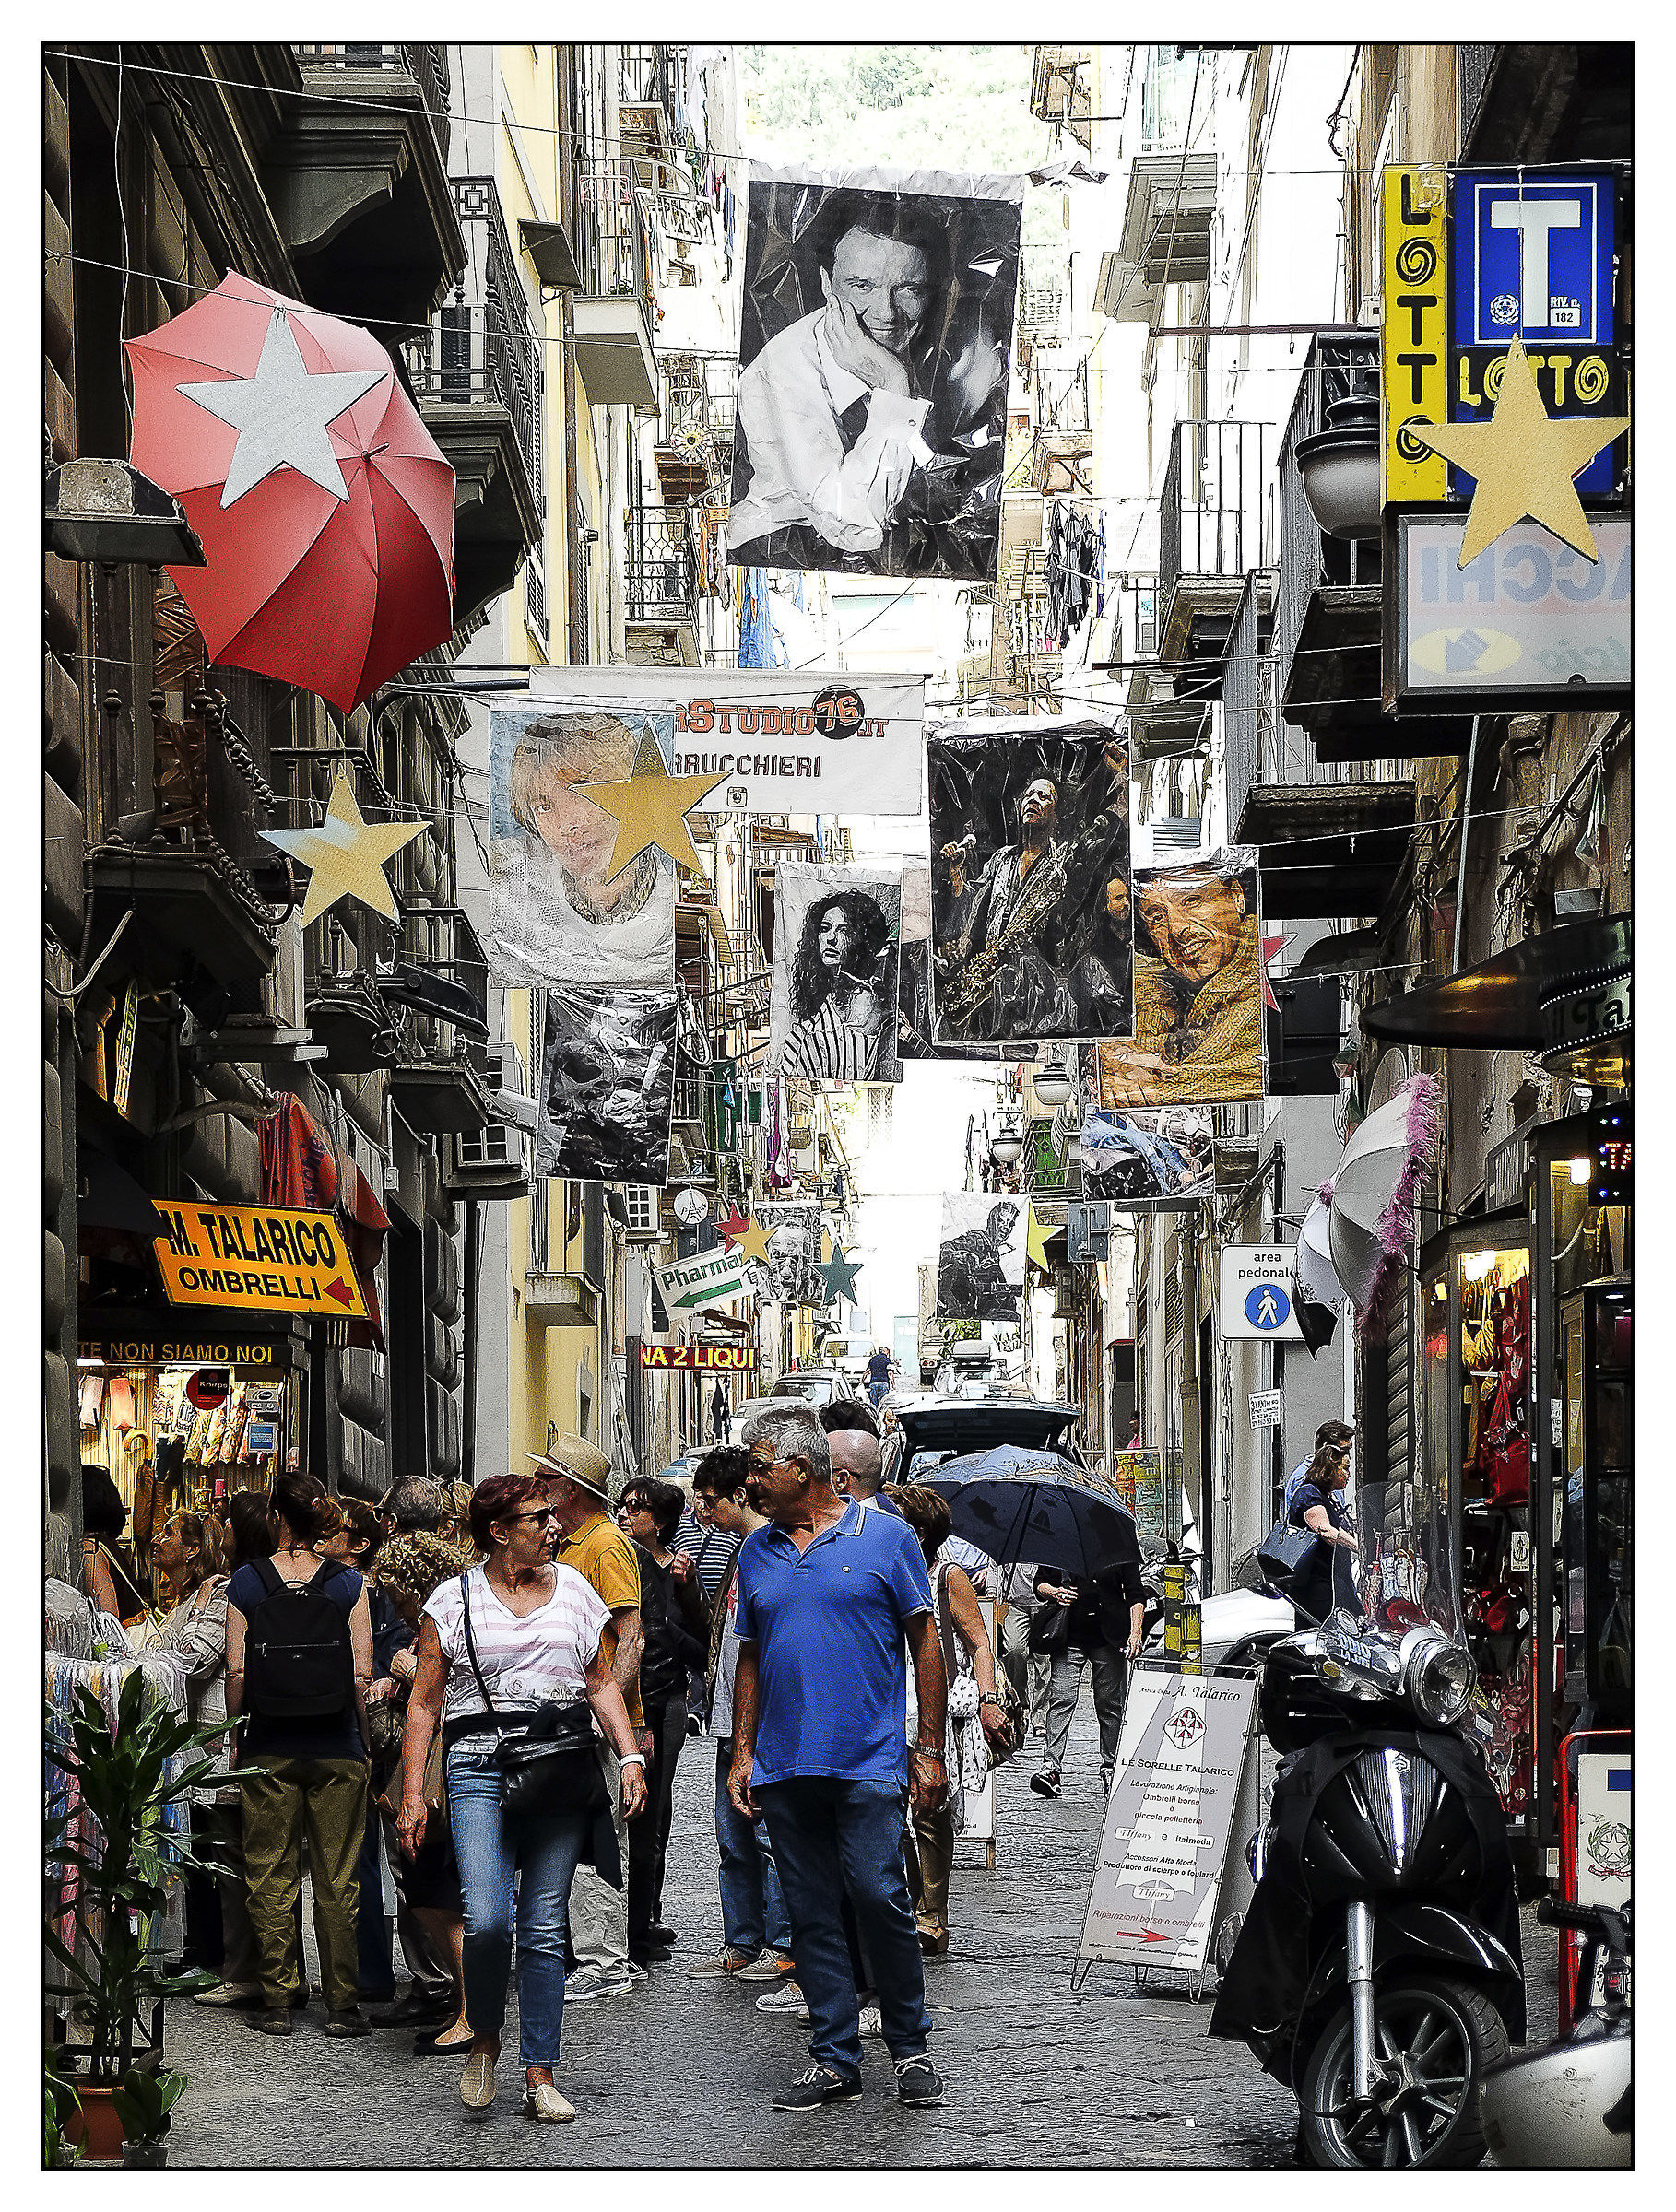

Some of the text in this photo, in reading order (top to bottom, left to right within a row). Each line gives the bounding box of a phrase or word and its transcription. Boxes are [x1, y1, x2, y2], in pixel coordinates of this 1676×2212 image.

[1490, 200, 1582, 327] T
[1395, 173, 1438, 464] LOTTO
[1554, 312, 1575, 323] 182
[159, 1209, 336, 1270] M. TALARICO
[1253, 1253, 1282, 1263] area
[660, 1253, 758, 1292] Pharma
[1238, 1266, 1293, 1280] pedonal
[177, 1265, 323, 1300] OMBRELLI
[110, 1343, 154, 1359] NON
[161, 1344, 229, 1362] SIAMO
[236, 1345, 272, 1363] NOI
[673, 1347, 688, 1367] 2
[694, 1347, 756, 1369] LIQUI
[1172, 1685, 1187, 1698] A.
[1193, 1686, 1241, 1702] Talarico
[1121, 1758, 1235, 1777] LE SORELLE TALARICO
[1130, 1779, 1219, 1795] Lavorazione Artigianale:
[1142, 1793, 1200, 1806] Ombrelli borse
[1134, 1811, 1203, 1826] piccola pelletteria
[1161, 1833, 1168, 1841] e
[1125, 1853, 1198, 1867] Accessori Alta Moda
[1103, 1860, 1142, 1871] Produttore
[1152, 1866, 1180, 1877] sciarpe
[1186, 1870, 1215, 1880] foulard
[1092, 1909, 1139, 1922] Riparazioni
[1139, 1914, 1163, 1925] borse
[1172, 1919, 1206, 1928] ombrelli
